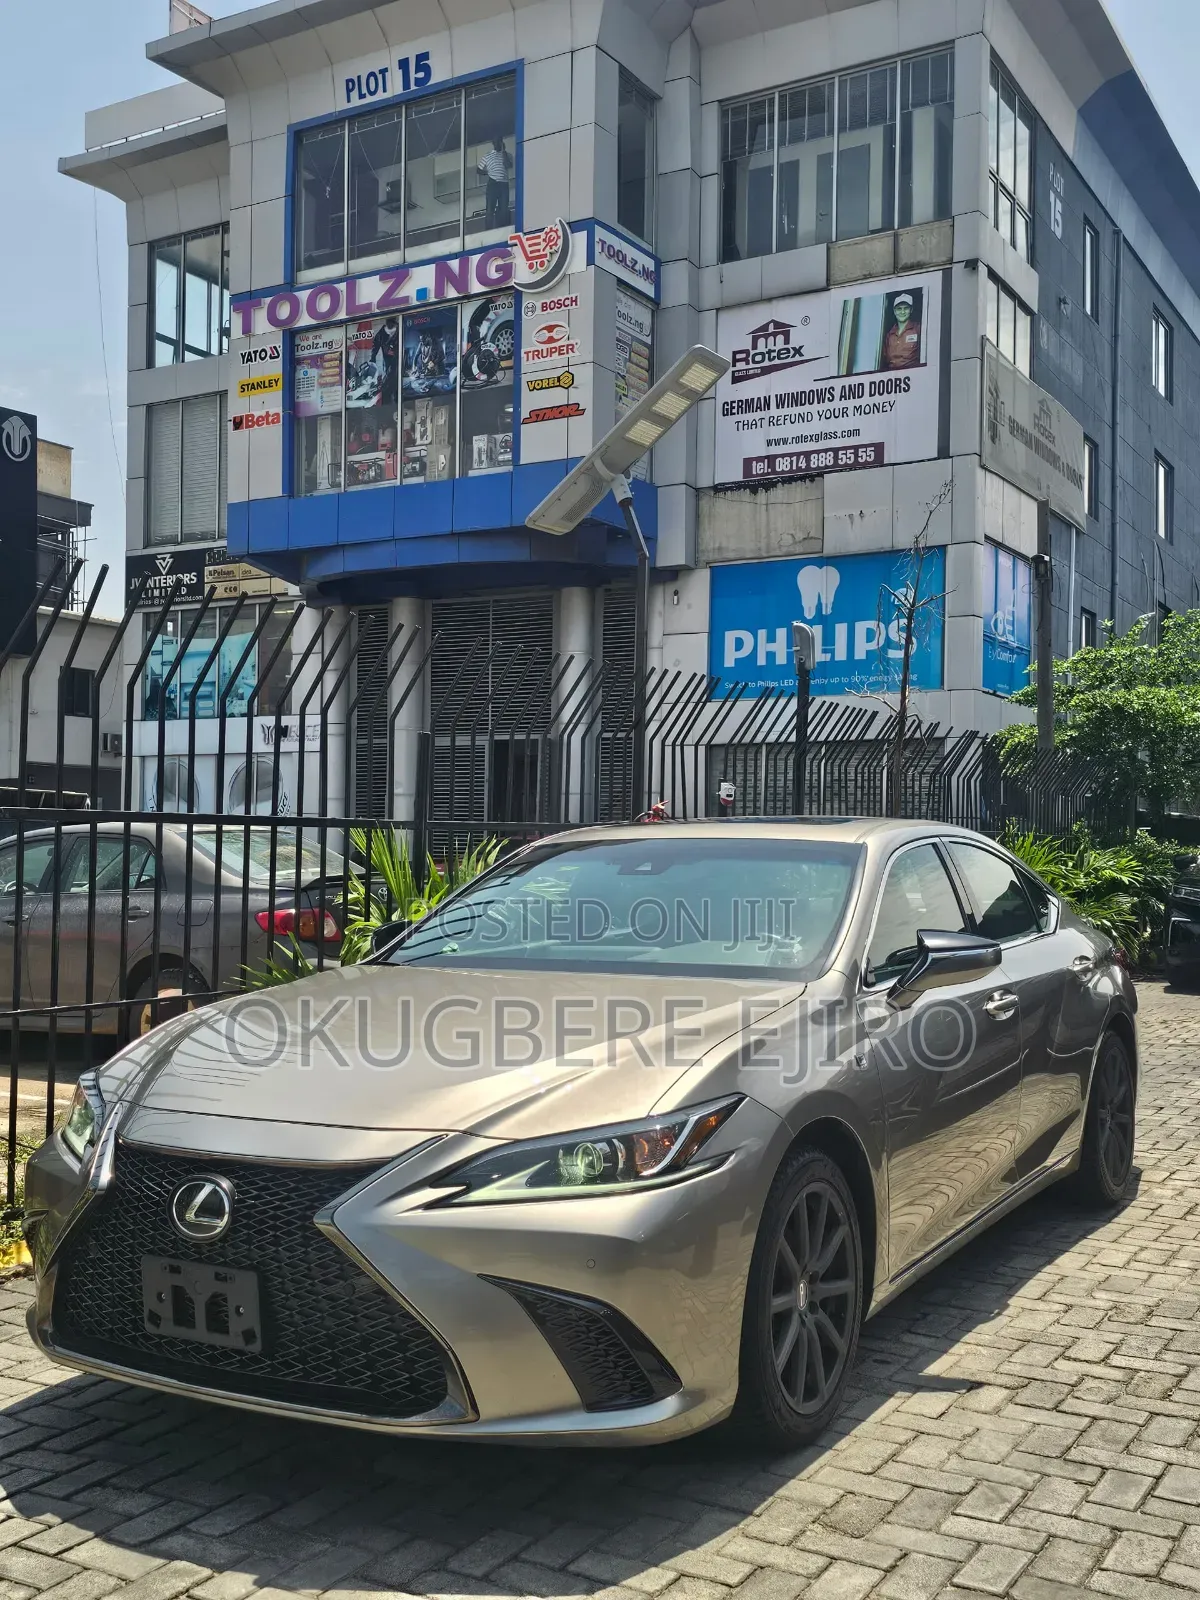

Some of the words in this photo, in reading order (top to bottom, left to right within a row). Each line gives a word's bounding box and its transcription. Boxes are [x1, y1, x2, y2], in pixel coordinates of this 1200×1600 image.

[345, 67, 389, 103] PLOT
[398, 51, 432, 92] 15
[1049, 162, 1064, 197] PLOT
[1049, 189, 1062, 240] 15
[598, 237, 657, 285] TOOLZ.NG
[232, 247, 517, 335] TOOLZ.NG
[541, 295, 579, 312] BOSCH
[616, 308, 644, 333] oolz.ng
[295, 340, 334, 353] Toolz.ng
[299, 334, 310, 342] We
[240, 347, 268, 365] YATO
[524, 343, 576, 362] TRUPER
[732, 345, 805, 368] Rotex
[240, 378, 280, 393] STANLEY
[528, 376, 560, 391] VOREL
[722, 394, 771, 417] GERMAN
[775, 386, 835, 409] WINDOWS
[839, 382, 865, 401] AND
[869, 376, 911, 398] DOORS
[244, 411, 281, 429] Beta
[735, 417, 765, 432] THAT
[768, 411, 813, 427] REFUND
[817, 406, 849, 421] YOUR
[853, 400, 896, 417] MONEY
[766, 428, 861, 448] www.rotexglass.com
[752, 460, 771, 475] tel.
[775, 455, 806, 472] 0814
[810, 451, 834, 468] 888
[838, 448, 856, 464] 55
[858, 447, 875, 462] 55
[723, 618, 917, 668] PHLIPS
[757, 680, 779, 690] Philips
[830, 677, 840, 686] up
